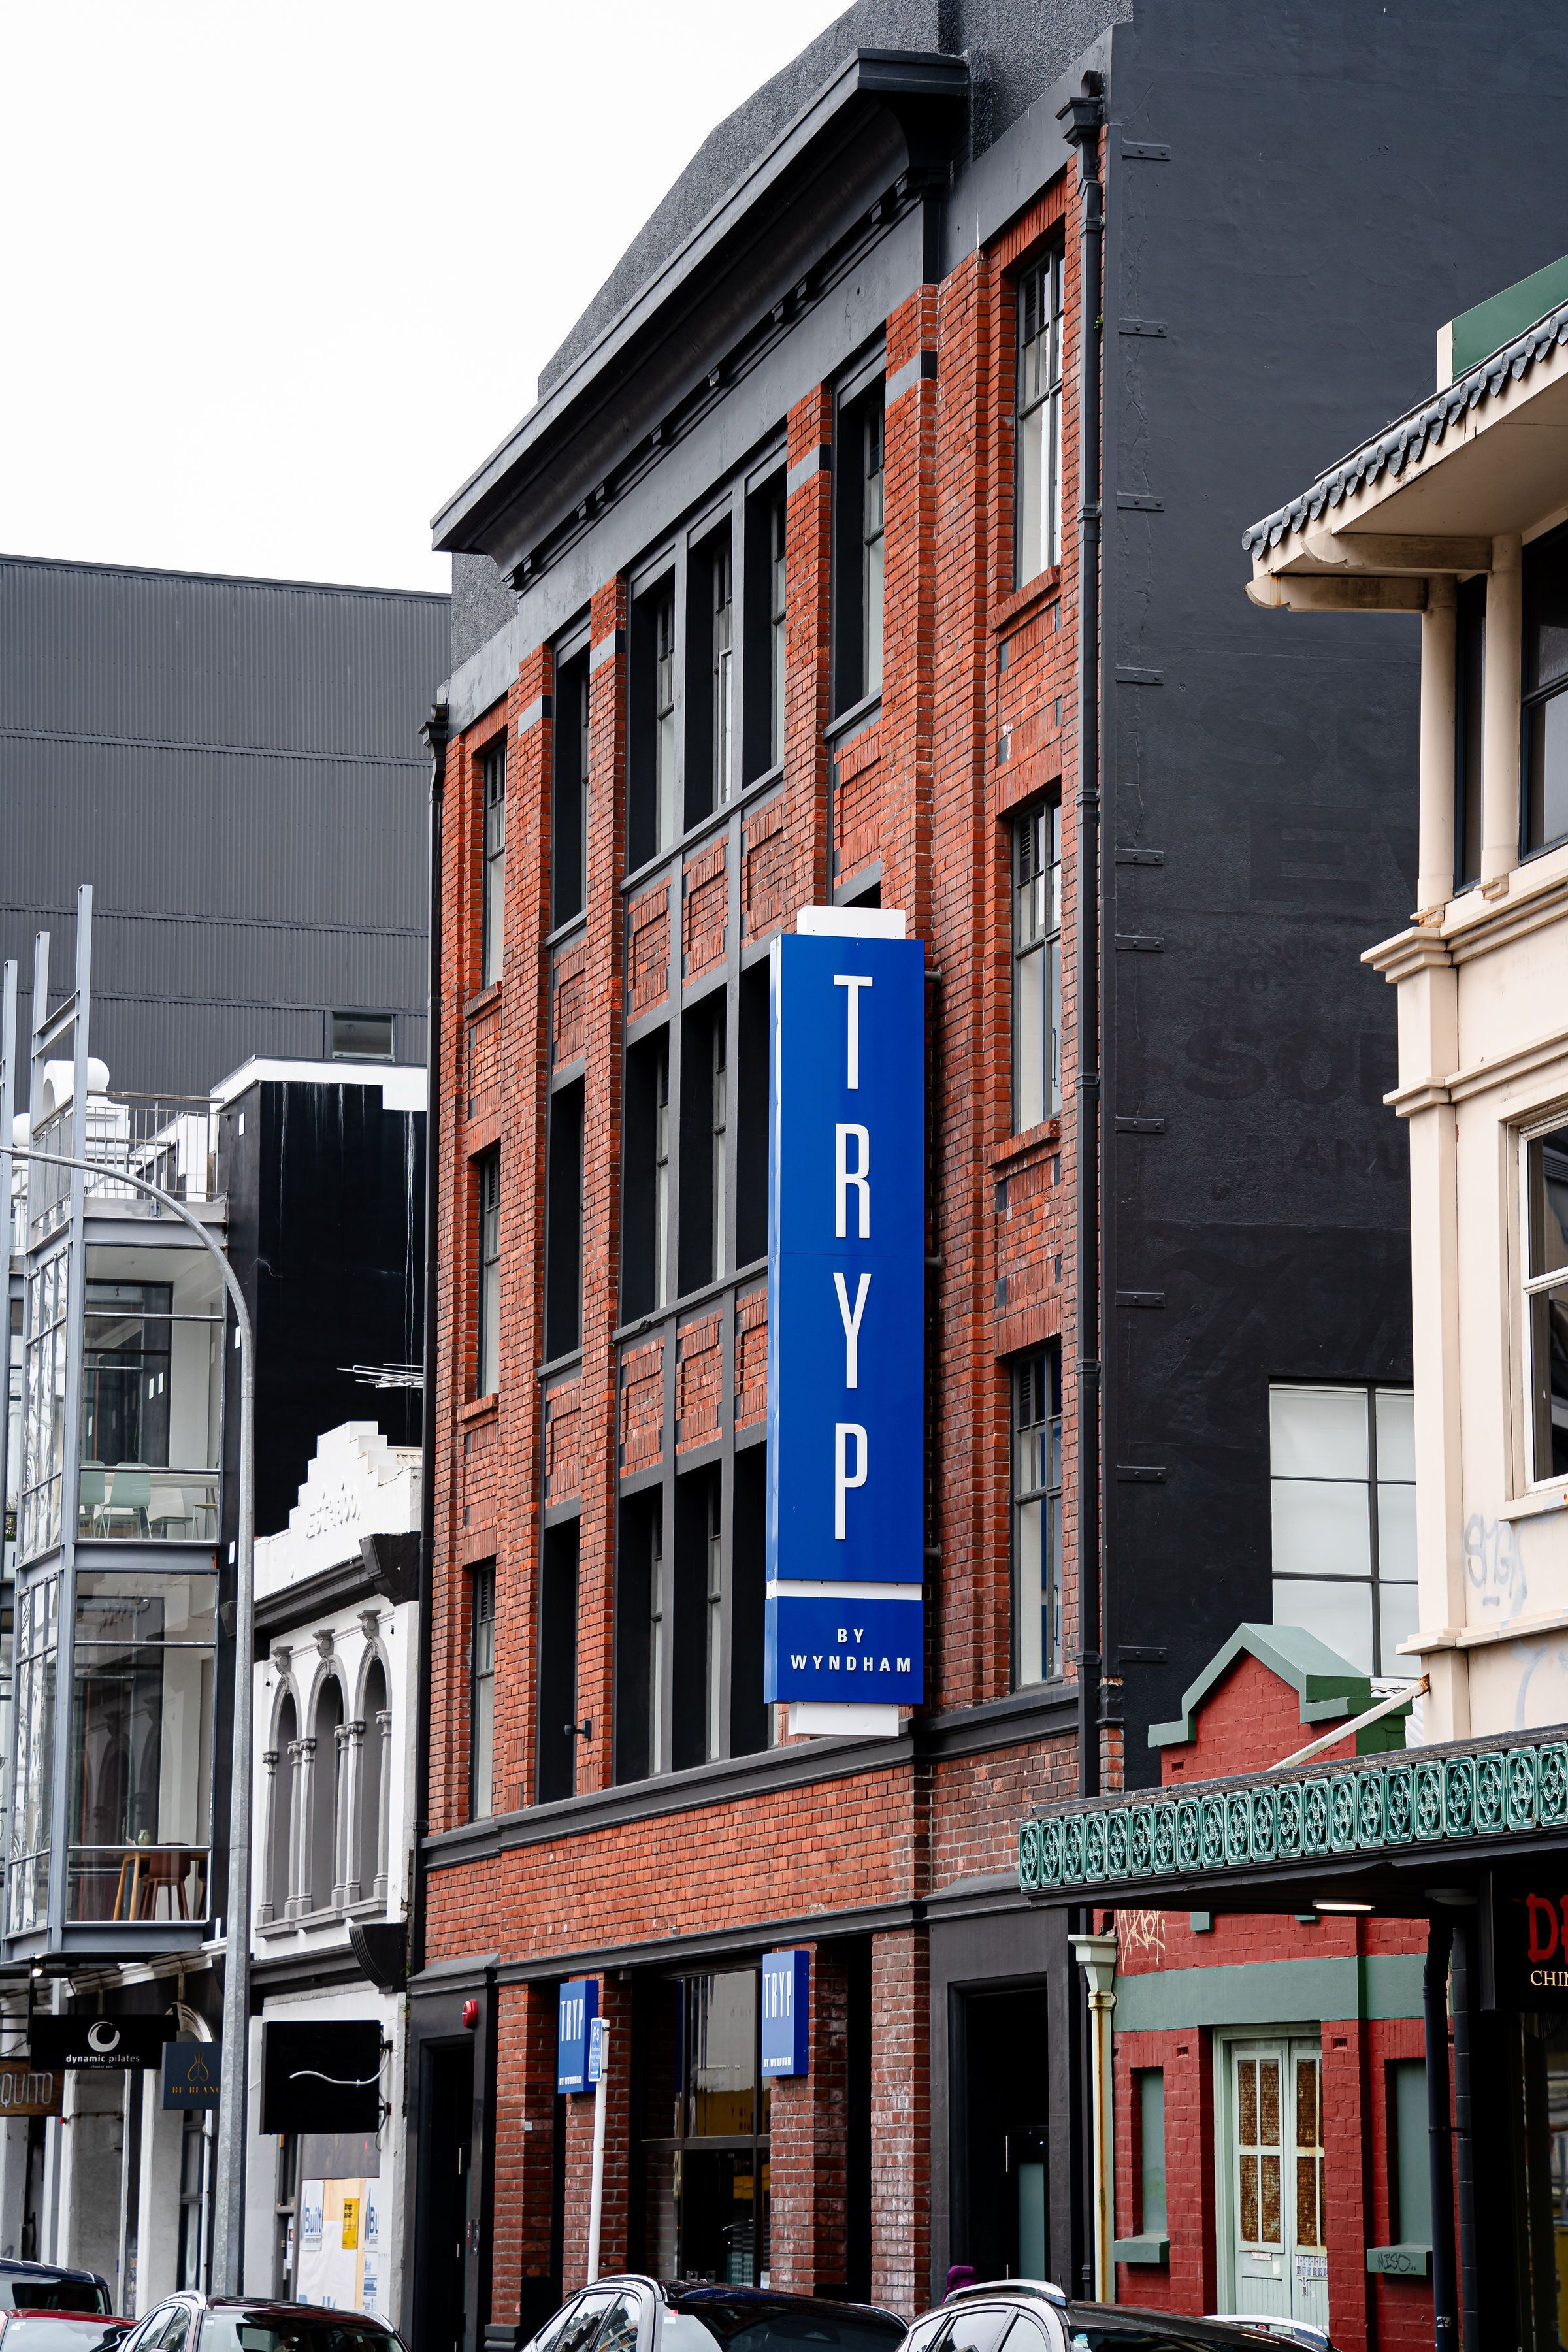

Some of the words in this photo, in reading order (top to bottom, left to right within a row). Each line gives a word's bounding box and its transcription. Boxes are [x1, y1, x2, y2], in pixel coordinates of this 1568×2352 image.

[832, 975, 873, 1540] TRYP
[837, 1628, 864, 1644] BY
[791, 1654, 911, 1673] WYNDHAM
[764, 1970, 792, 2019] TRYP
[561, 1998, 583, 2042] TRYP
[66, 2054, 106, 2064] dynamic
[108, 2054, 140, 2064] pilates
[763, 2059, 770, 2068] BY
[770, 2057, 792, 2068] WYNDHAM
[1, 2072, 54, 2108] QUITO
[305, 2206, 322, 2233] Built
